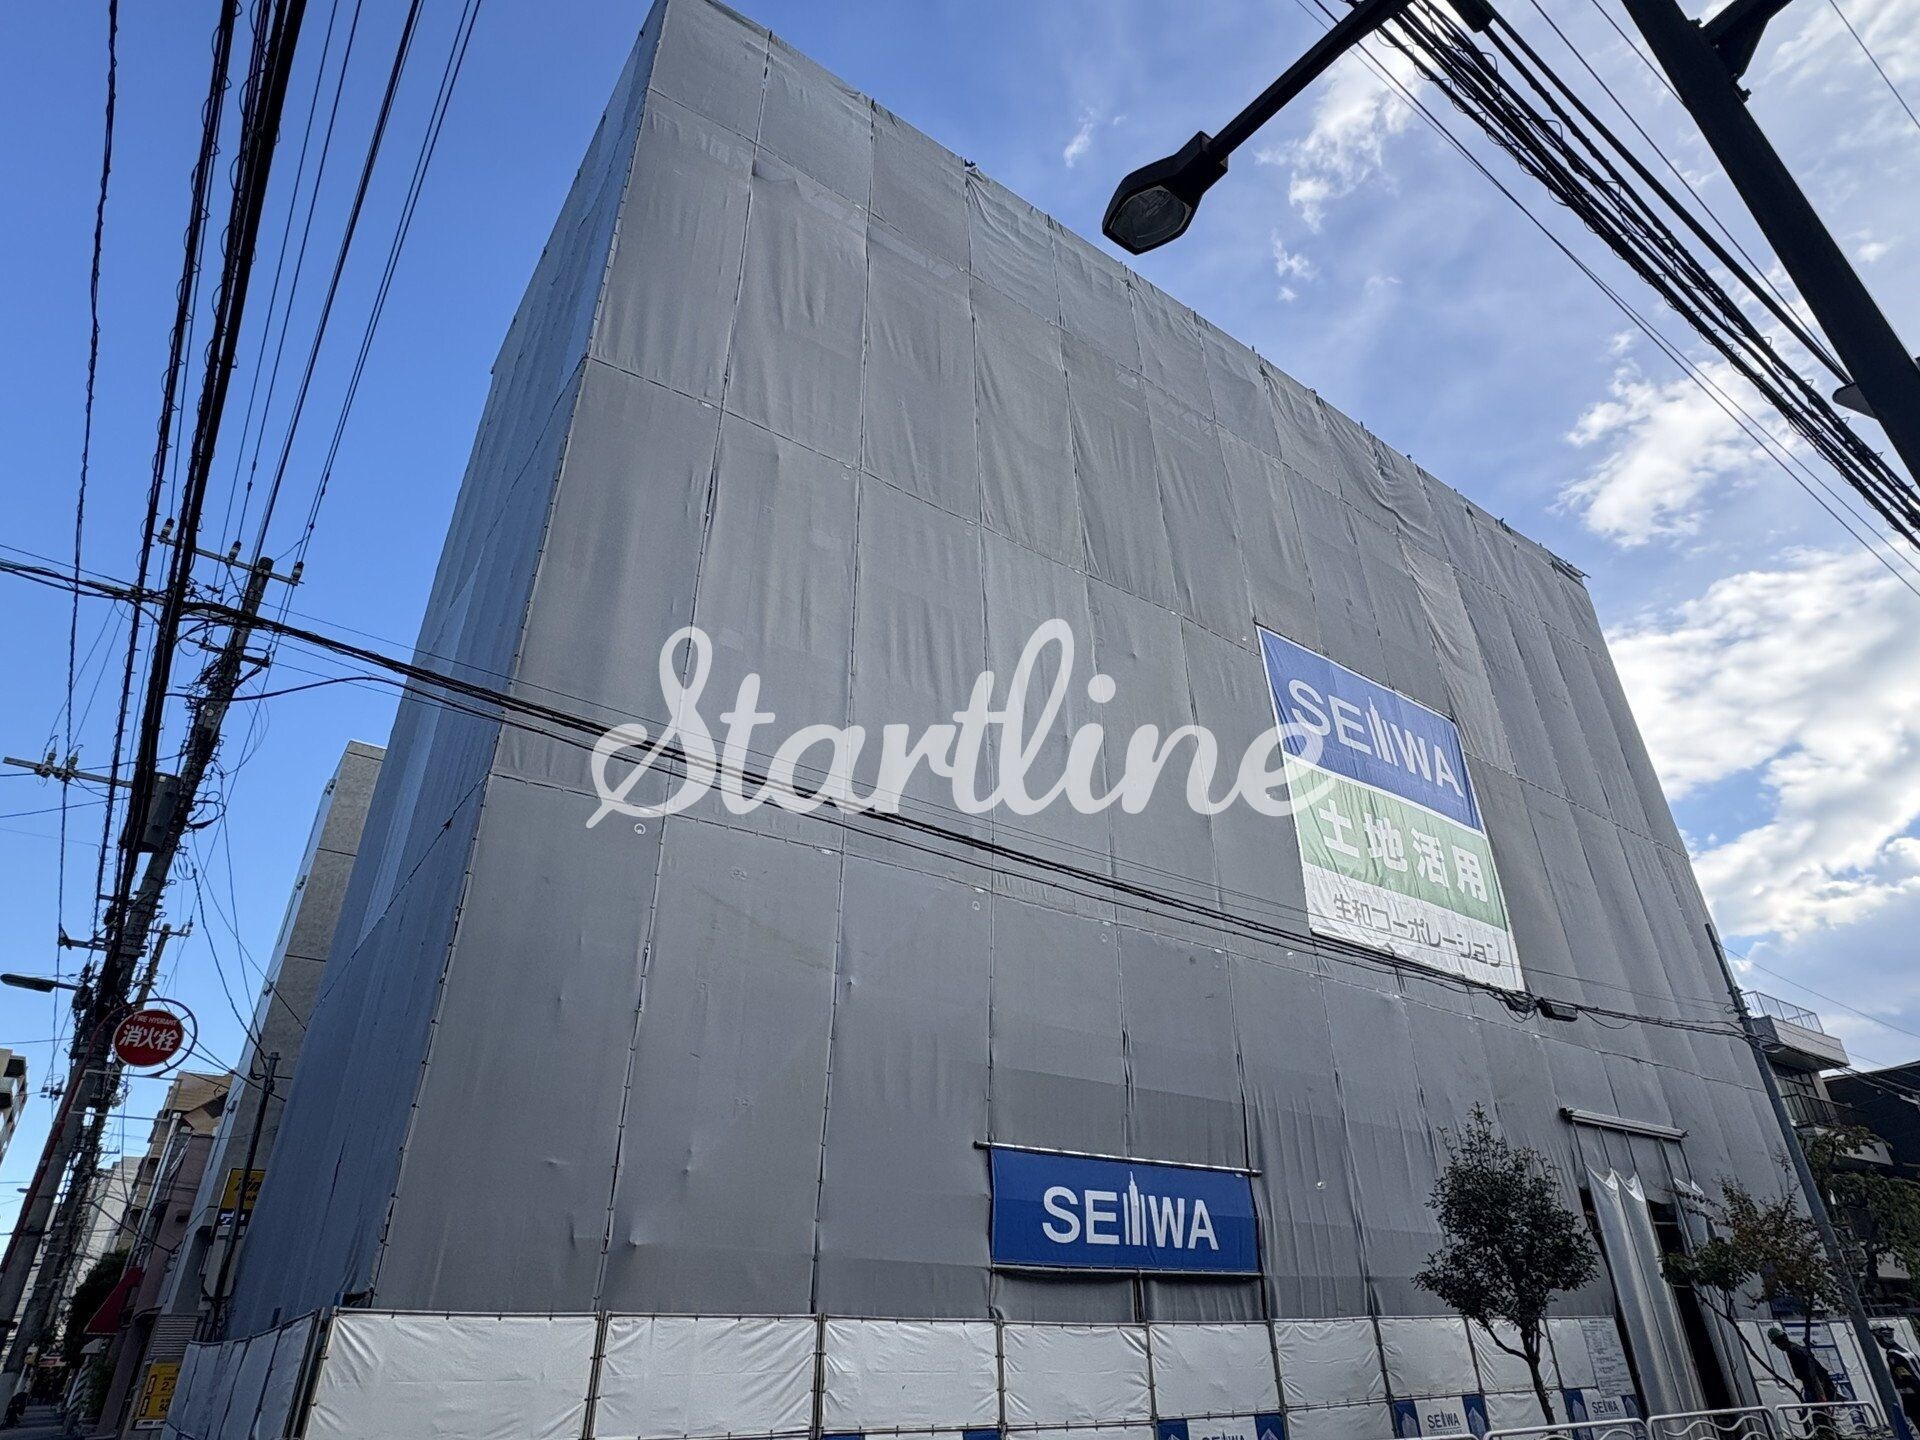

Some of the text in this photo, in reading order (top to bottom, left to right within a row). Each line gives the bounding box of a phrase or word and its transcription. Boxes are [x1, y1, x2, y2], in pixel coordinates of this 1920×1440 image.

[1288, 679, 1464, 798] SEIWA
[1317, 798, 1489, 903] 土地活用
[1332, 894, 1502, 968] 生和コーポレーション
[117, 1024, 179, 1052] 消火栓
[133, 1014, 177, 1027] FIRE HYDRANT
[1041, 1170, 1220, 1251] SEIWA
[1427, 1409, 1462, 1429] SEIWA
